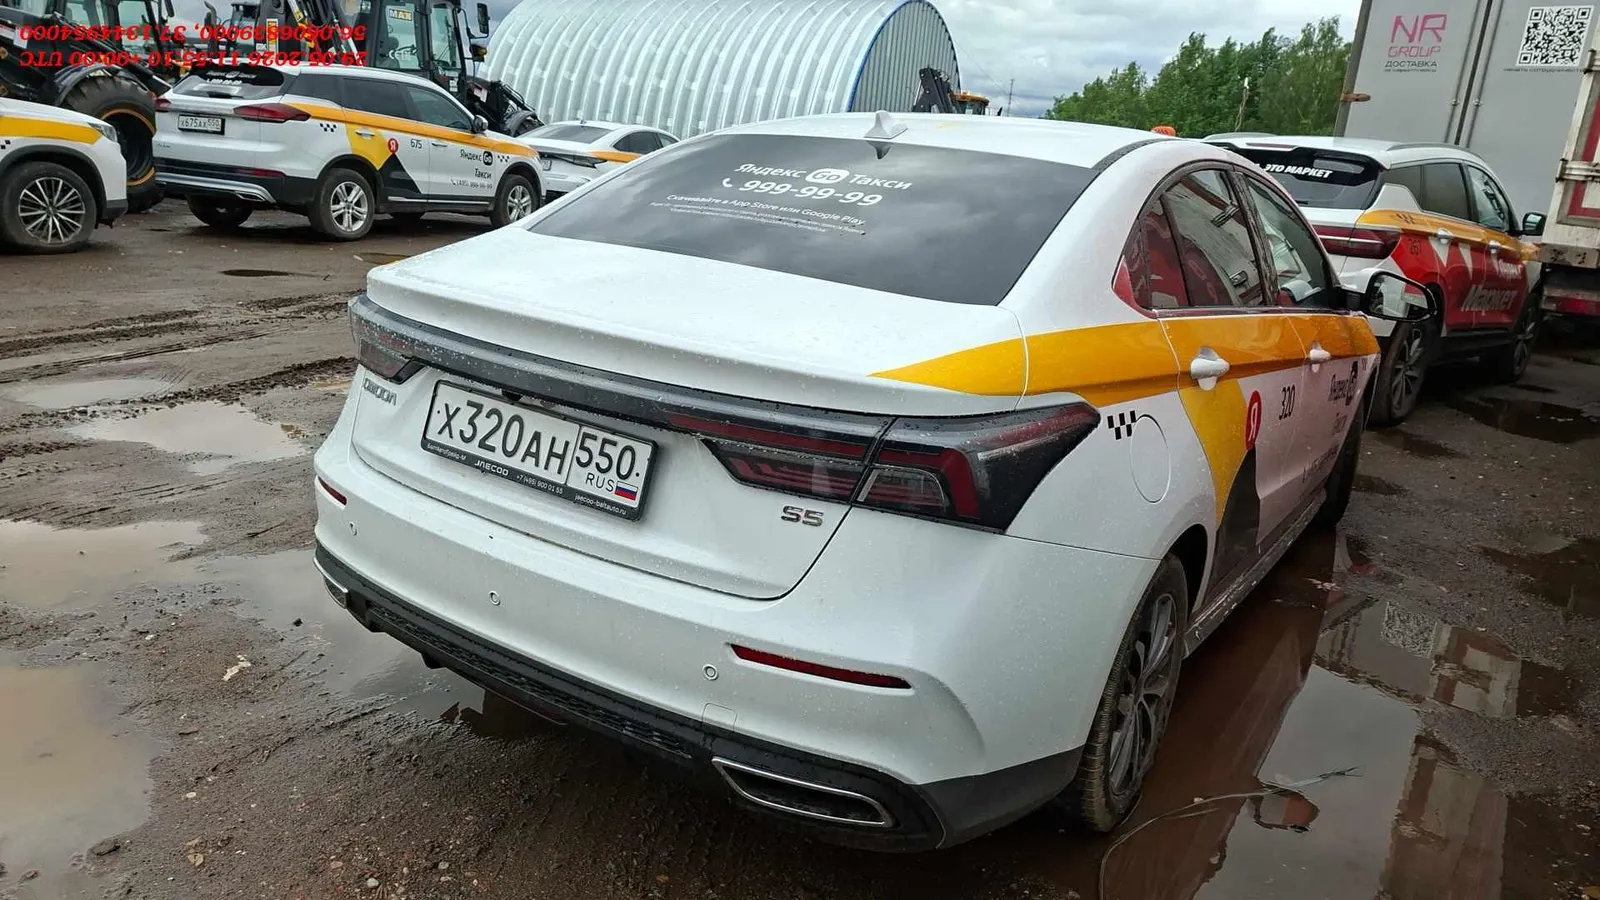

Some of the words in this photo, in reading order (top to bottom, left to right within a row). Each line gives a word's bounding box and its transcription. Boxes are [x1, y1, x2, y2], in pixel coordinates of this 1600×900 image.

[1390, 14, 1447, 43] NR
[1388, 46, 1441, 58] GROUP
[1385, 60, 1438, 68] ДОСТАВКА
[410, 138, 422, 150] 675
[459, 149, 482, 162] Яндекс
[474, 168, 492, 180] Такси
[734, 163, 807, 178] Яндекс
[849, 174, 913, 190] Такси
[1284, 166, 1333, 178] МАРКЕТ
[738, 180, 883, 206] 999-99-99
[729, 199, 750, 208] App
[750, 201, 779, 211] Store
[801, 208, 841, 220] Google
[840, 215, 866, 225] Play
[1461, 284, 1520, 314] Маркет
[1278, 384, 1296, 420] 320
[437, 400, 570, 475] Х320АН
[575, 433, 636, 480] 550
[585, 472, 614, 492] RUS
[781, 505, 824, 527] S5
